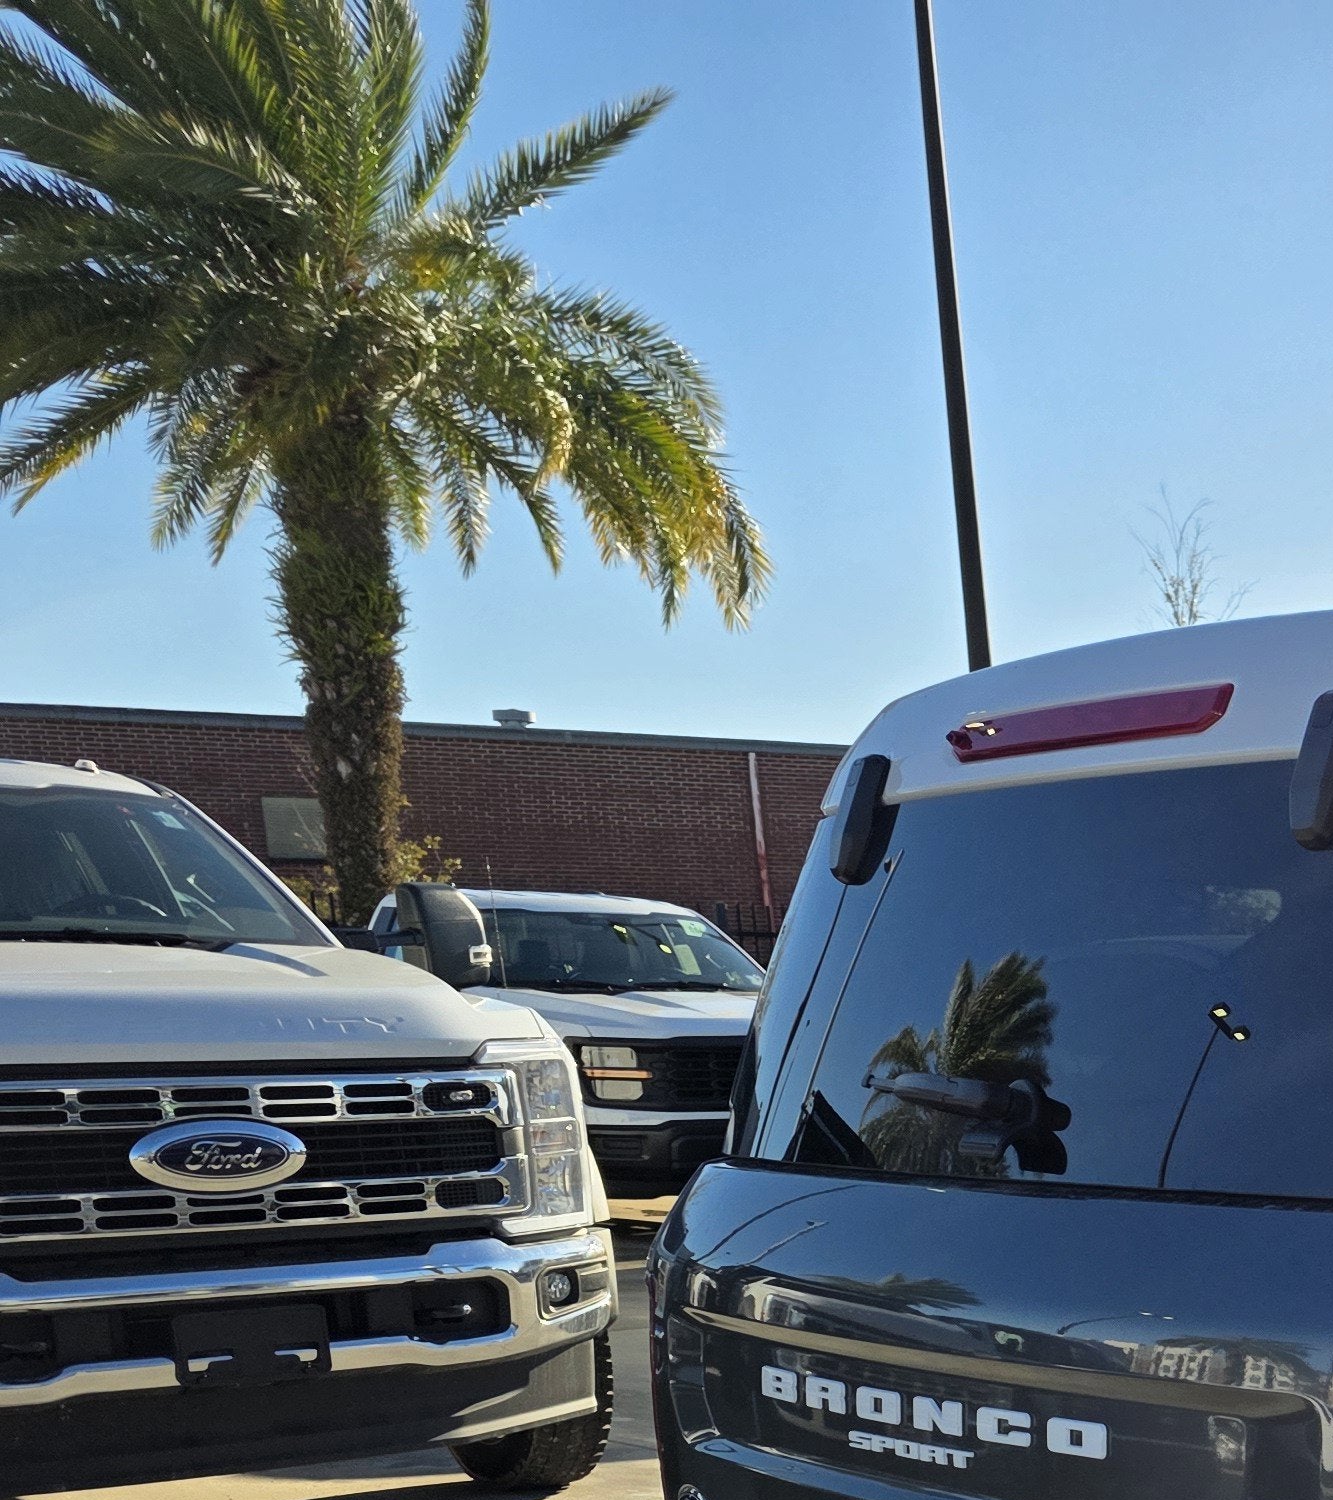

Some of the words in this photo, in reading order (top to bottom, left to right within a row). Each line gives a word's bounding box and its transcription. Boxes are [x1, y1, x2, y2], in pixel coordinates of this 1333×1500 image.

[185, 1140, 263, 1171] Ford
[761, 1365, 1108, 1460] BRONCO
[848, 1430, 975, 1469] SPORT
